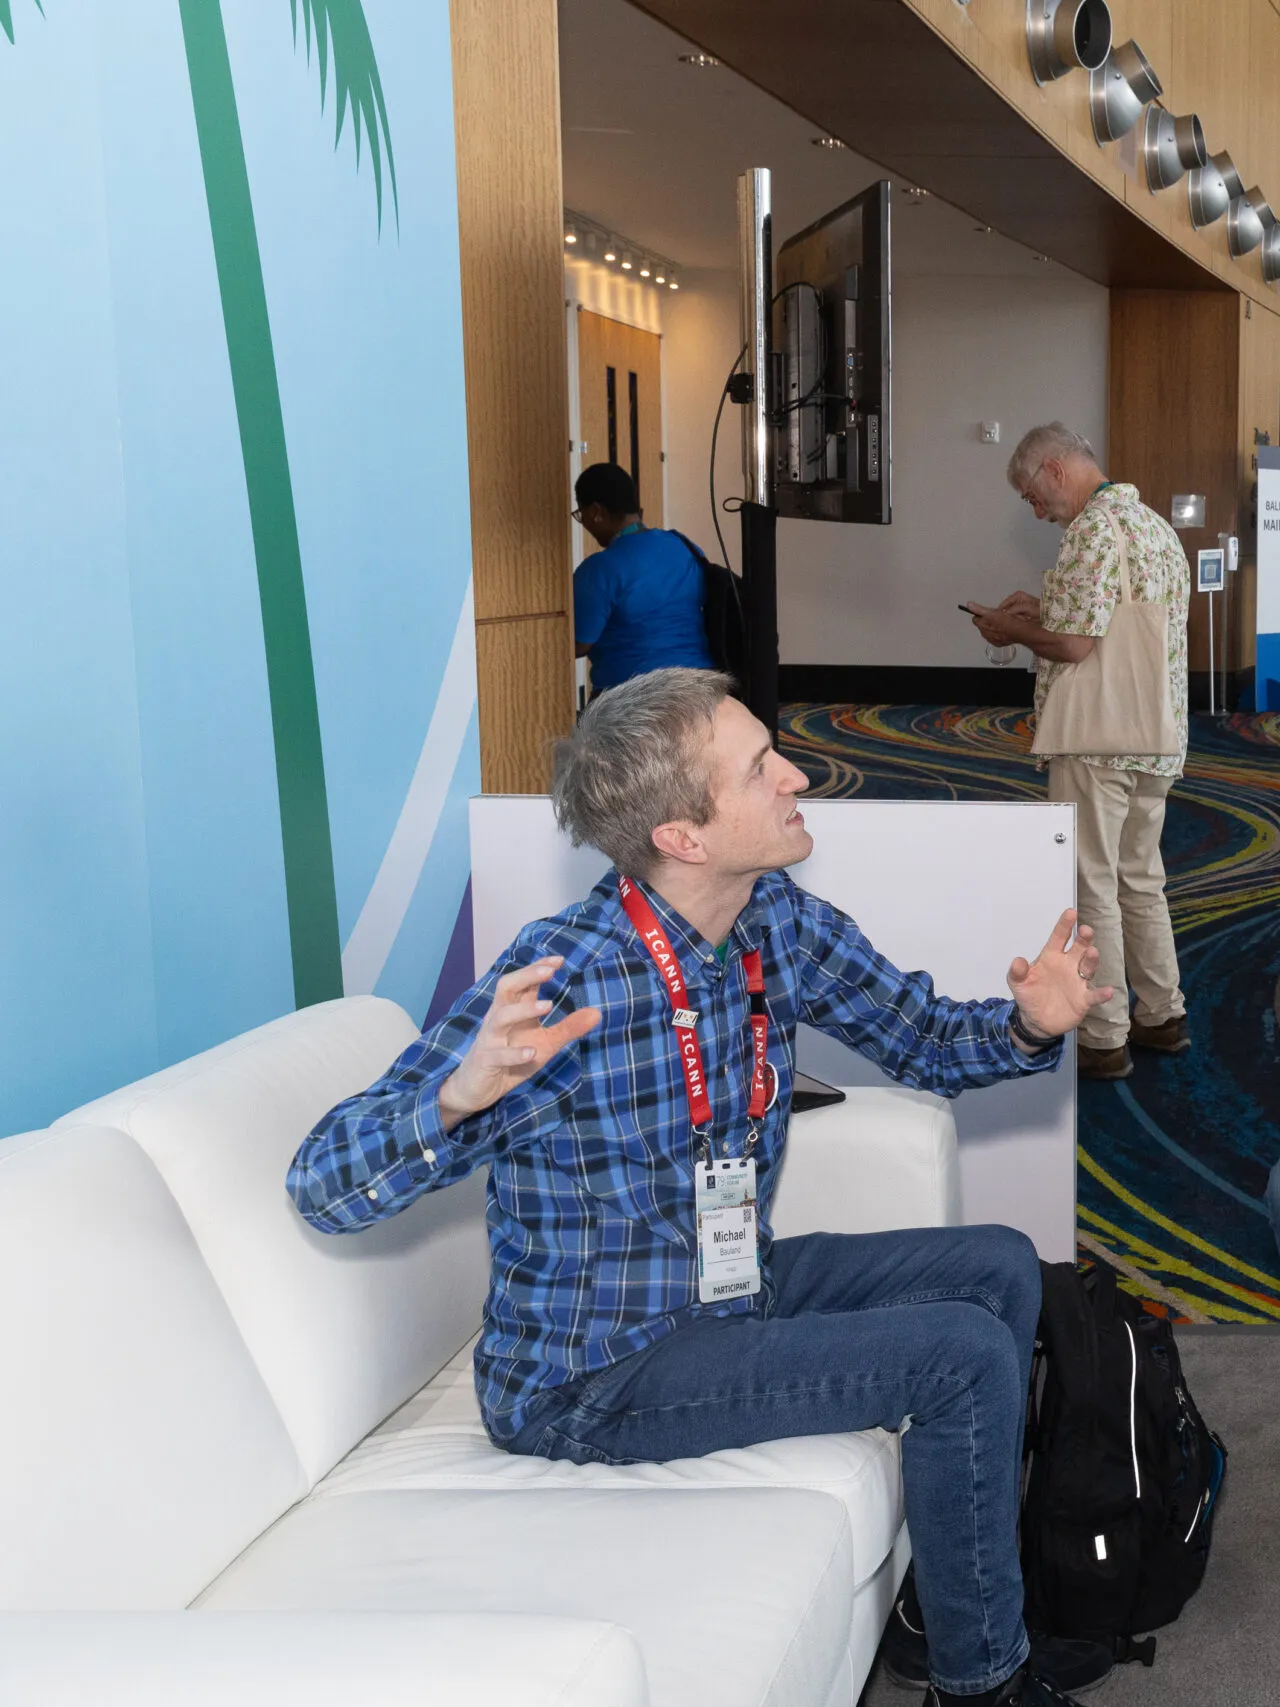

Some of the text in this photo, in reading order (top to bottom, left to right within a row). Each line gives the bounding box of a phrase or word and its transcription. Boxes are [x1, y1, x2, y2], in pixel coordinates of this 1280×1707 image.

[645, 928, 682, 993] ICANN
[682, 1032, 703, 1098] ICANN
[755, 1027, 764, 1090] ICANN
[713, 1228, 746, 1243] Michael
[713, 1281, 751, 1295] PARTICIPANT
